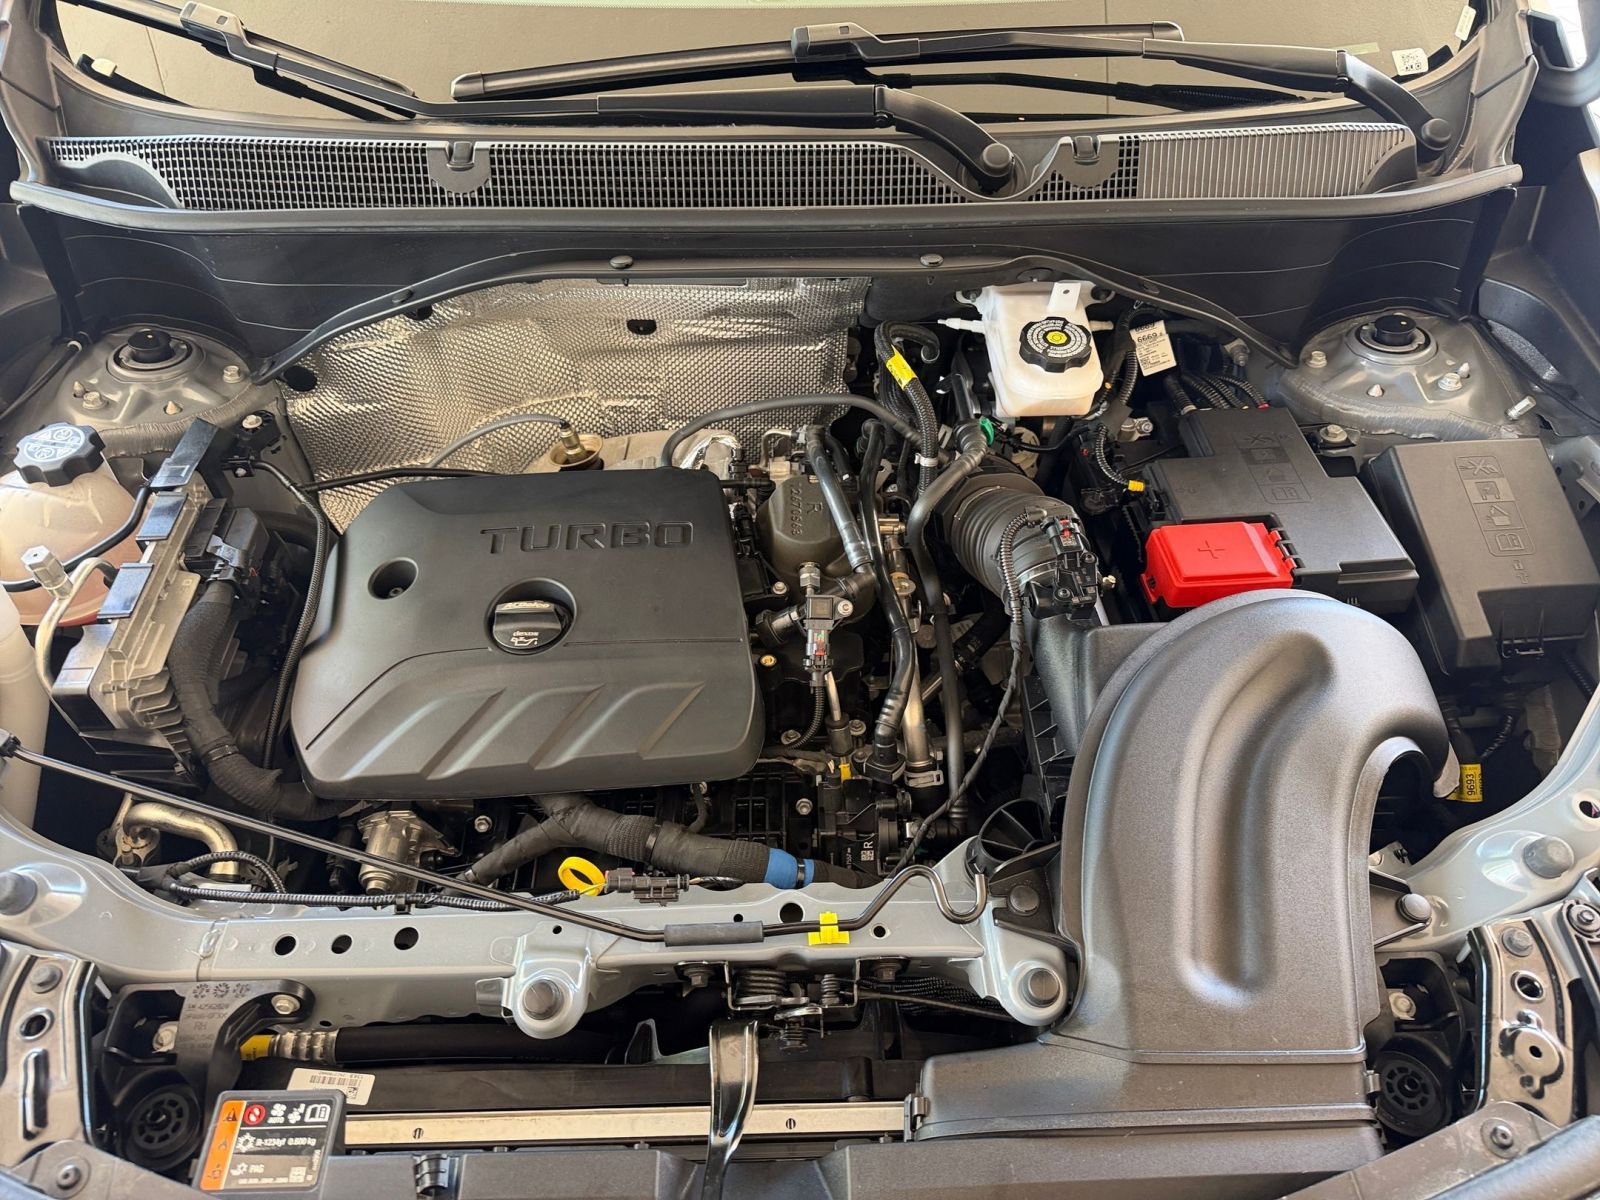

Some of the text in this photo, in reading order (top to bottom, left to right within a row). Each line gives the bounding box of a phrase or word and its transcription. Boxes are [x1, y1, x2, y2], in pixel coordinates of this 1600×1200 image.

[807, 502, 823, 514] R
[480, 521, 694, 554] TURBO
[1466, 773, 1475, 796] 9693
